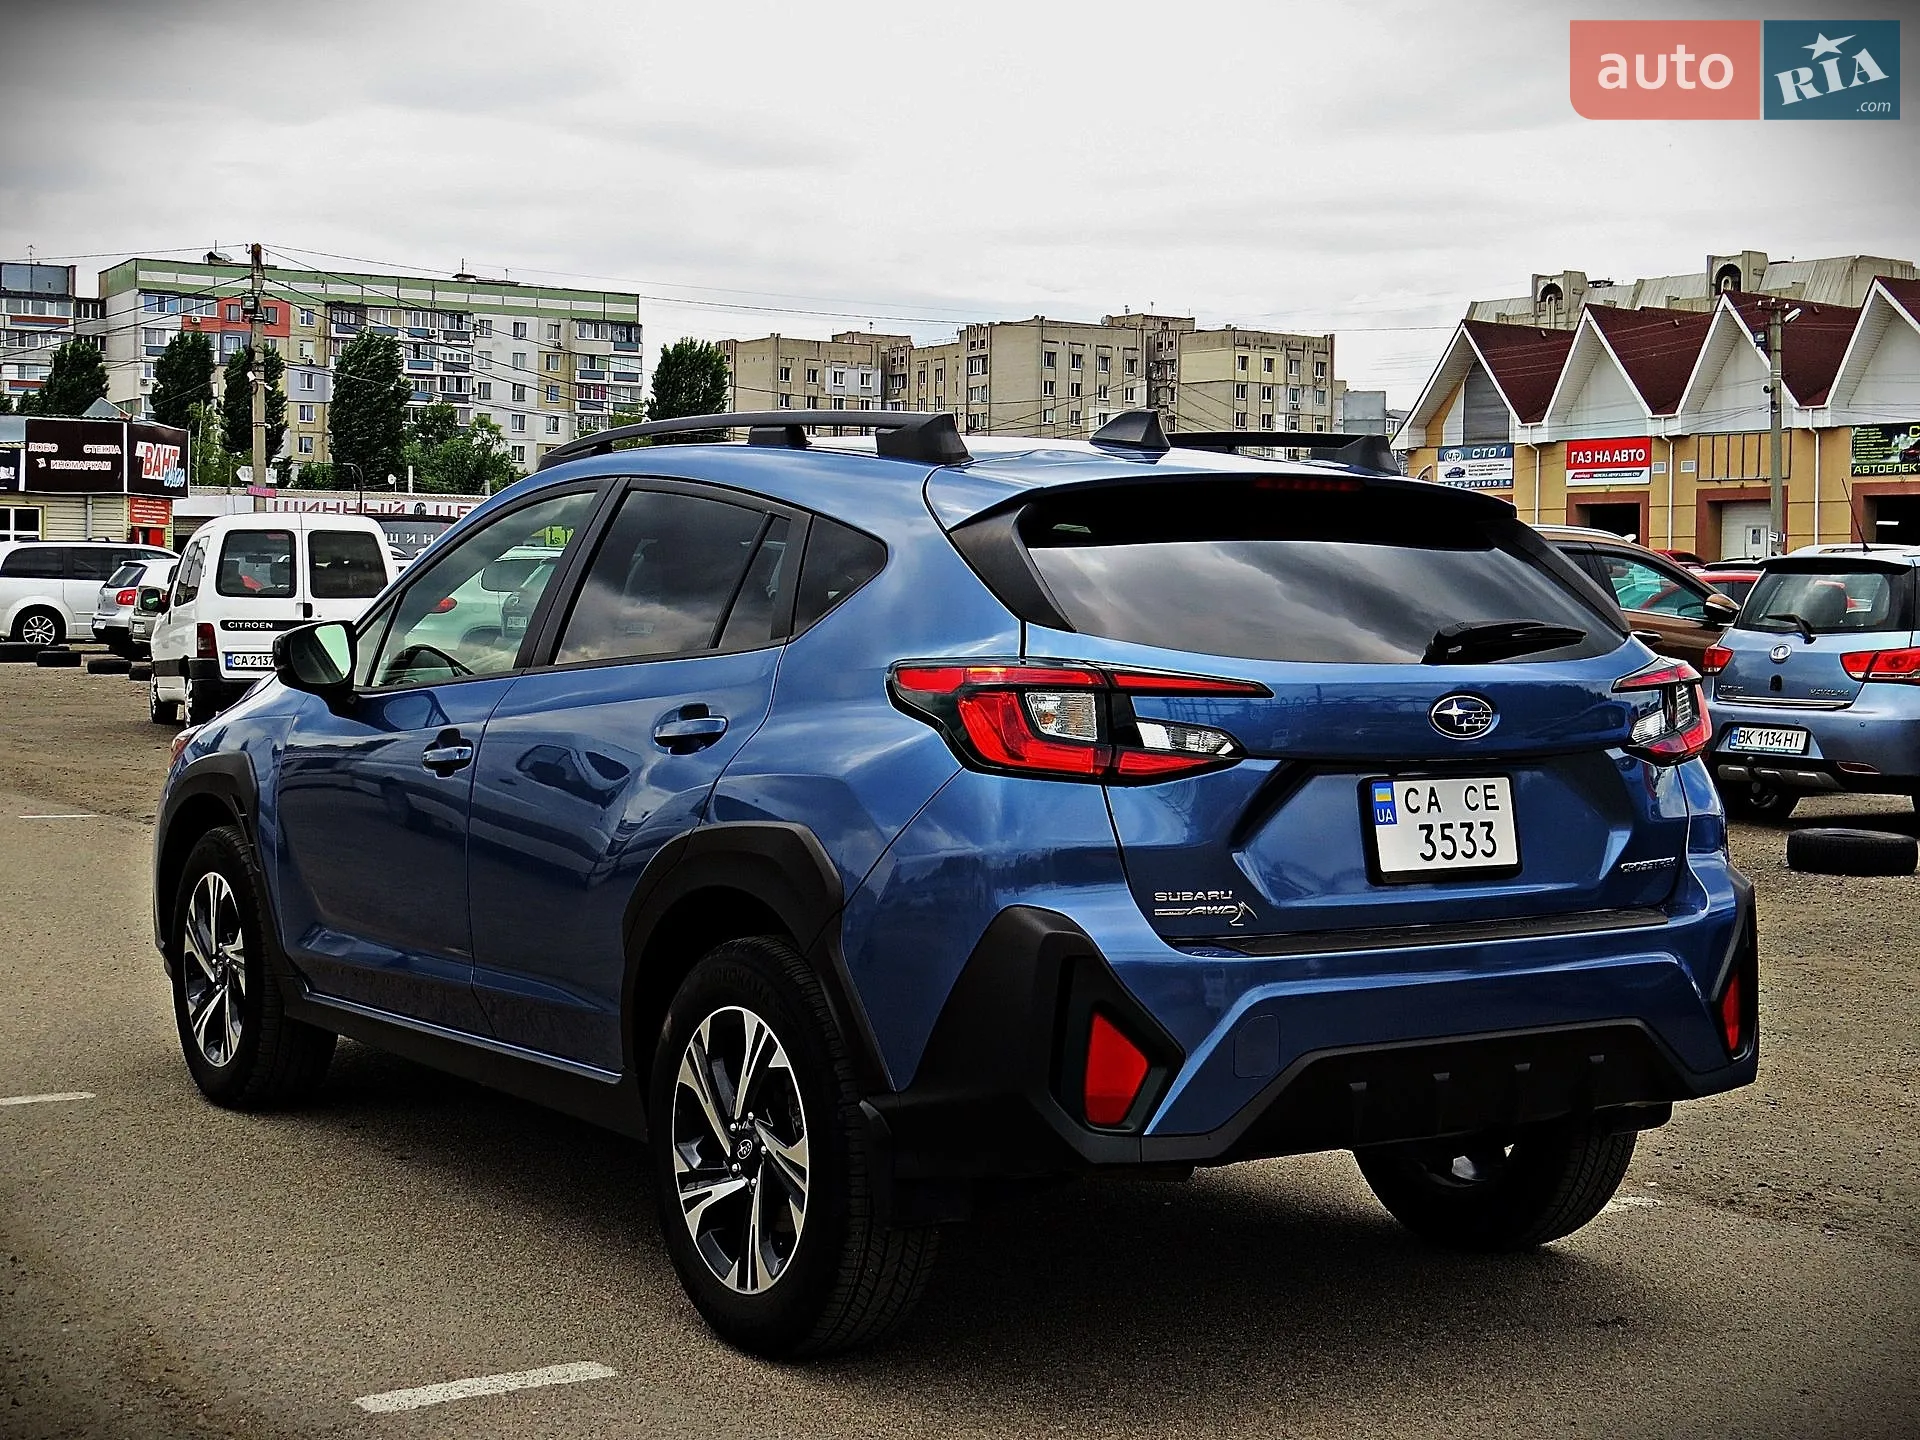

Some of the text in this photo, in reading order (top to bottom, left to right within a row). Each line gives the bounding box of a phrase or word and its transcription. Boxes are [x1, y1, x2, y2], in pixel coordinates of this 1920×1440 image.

[83, 444, 121, 455] СТЕКЛА
[1471, 447, 1497, 459] СТО
[1571, 448, 1646, 464] ГАЗ НА АВТО
[50, 460, 111, 470] ИНОМАРКАМ
[273, 501, 405, 514] ШИННЫЙ
[233, 655, 249, 666] CA
[1738, 729, 1756, 745] BK
[1757, 731, 1782, 747] 1134
[1404, 784, 1500, 814] CA CE
[1376, 808, 1394, 823] UA
[1418, 821, 1497, 861] 3533
[1154, 890, 1233, 901] SUBARU
[1187, 905, 1238, 915] AWD
